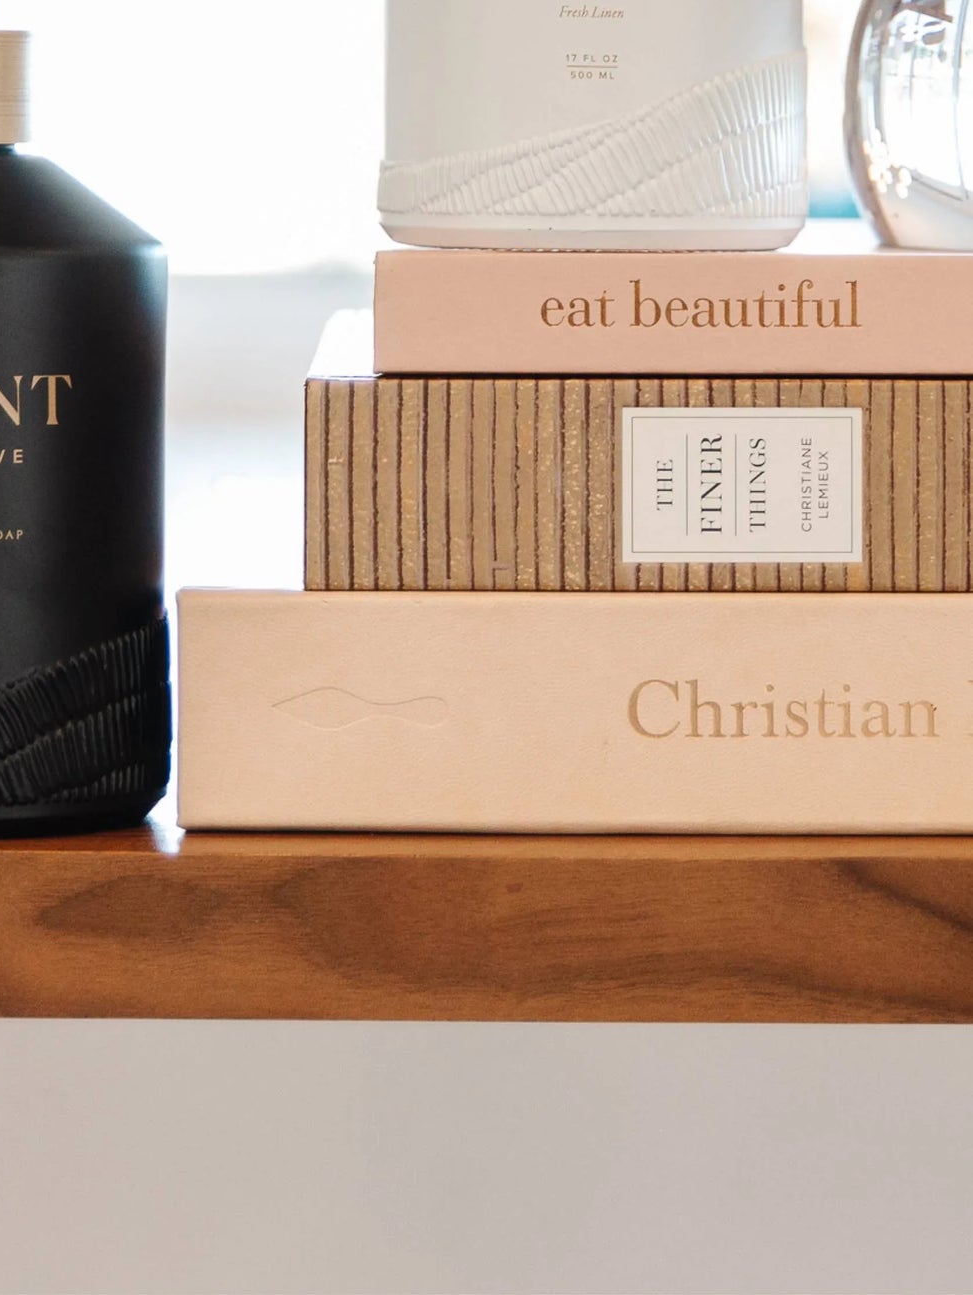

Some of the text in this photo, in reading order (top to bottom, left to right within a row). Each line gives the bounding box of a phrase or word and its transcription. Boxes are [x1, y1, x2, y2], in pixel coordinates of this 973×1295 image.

[559, 4, 625, 19] Fresh Linen
[565, 53, 618, 63] 17 FL OZ
[570, 70, 615, 80] 500 ML
[540, 278, 862, 328] eat beautiful
[656, 459, 673, 511] THE
[700, 435, 723, 533] FINER
[749, 438, 766, 533] THINGS
[800, 438, 813, 533] CHRISTIANE
[817, 451, 830, 519] LEMIEUX
[627, 678, 941, 739] Christian
